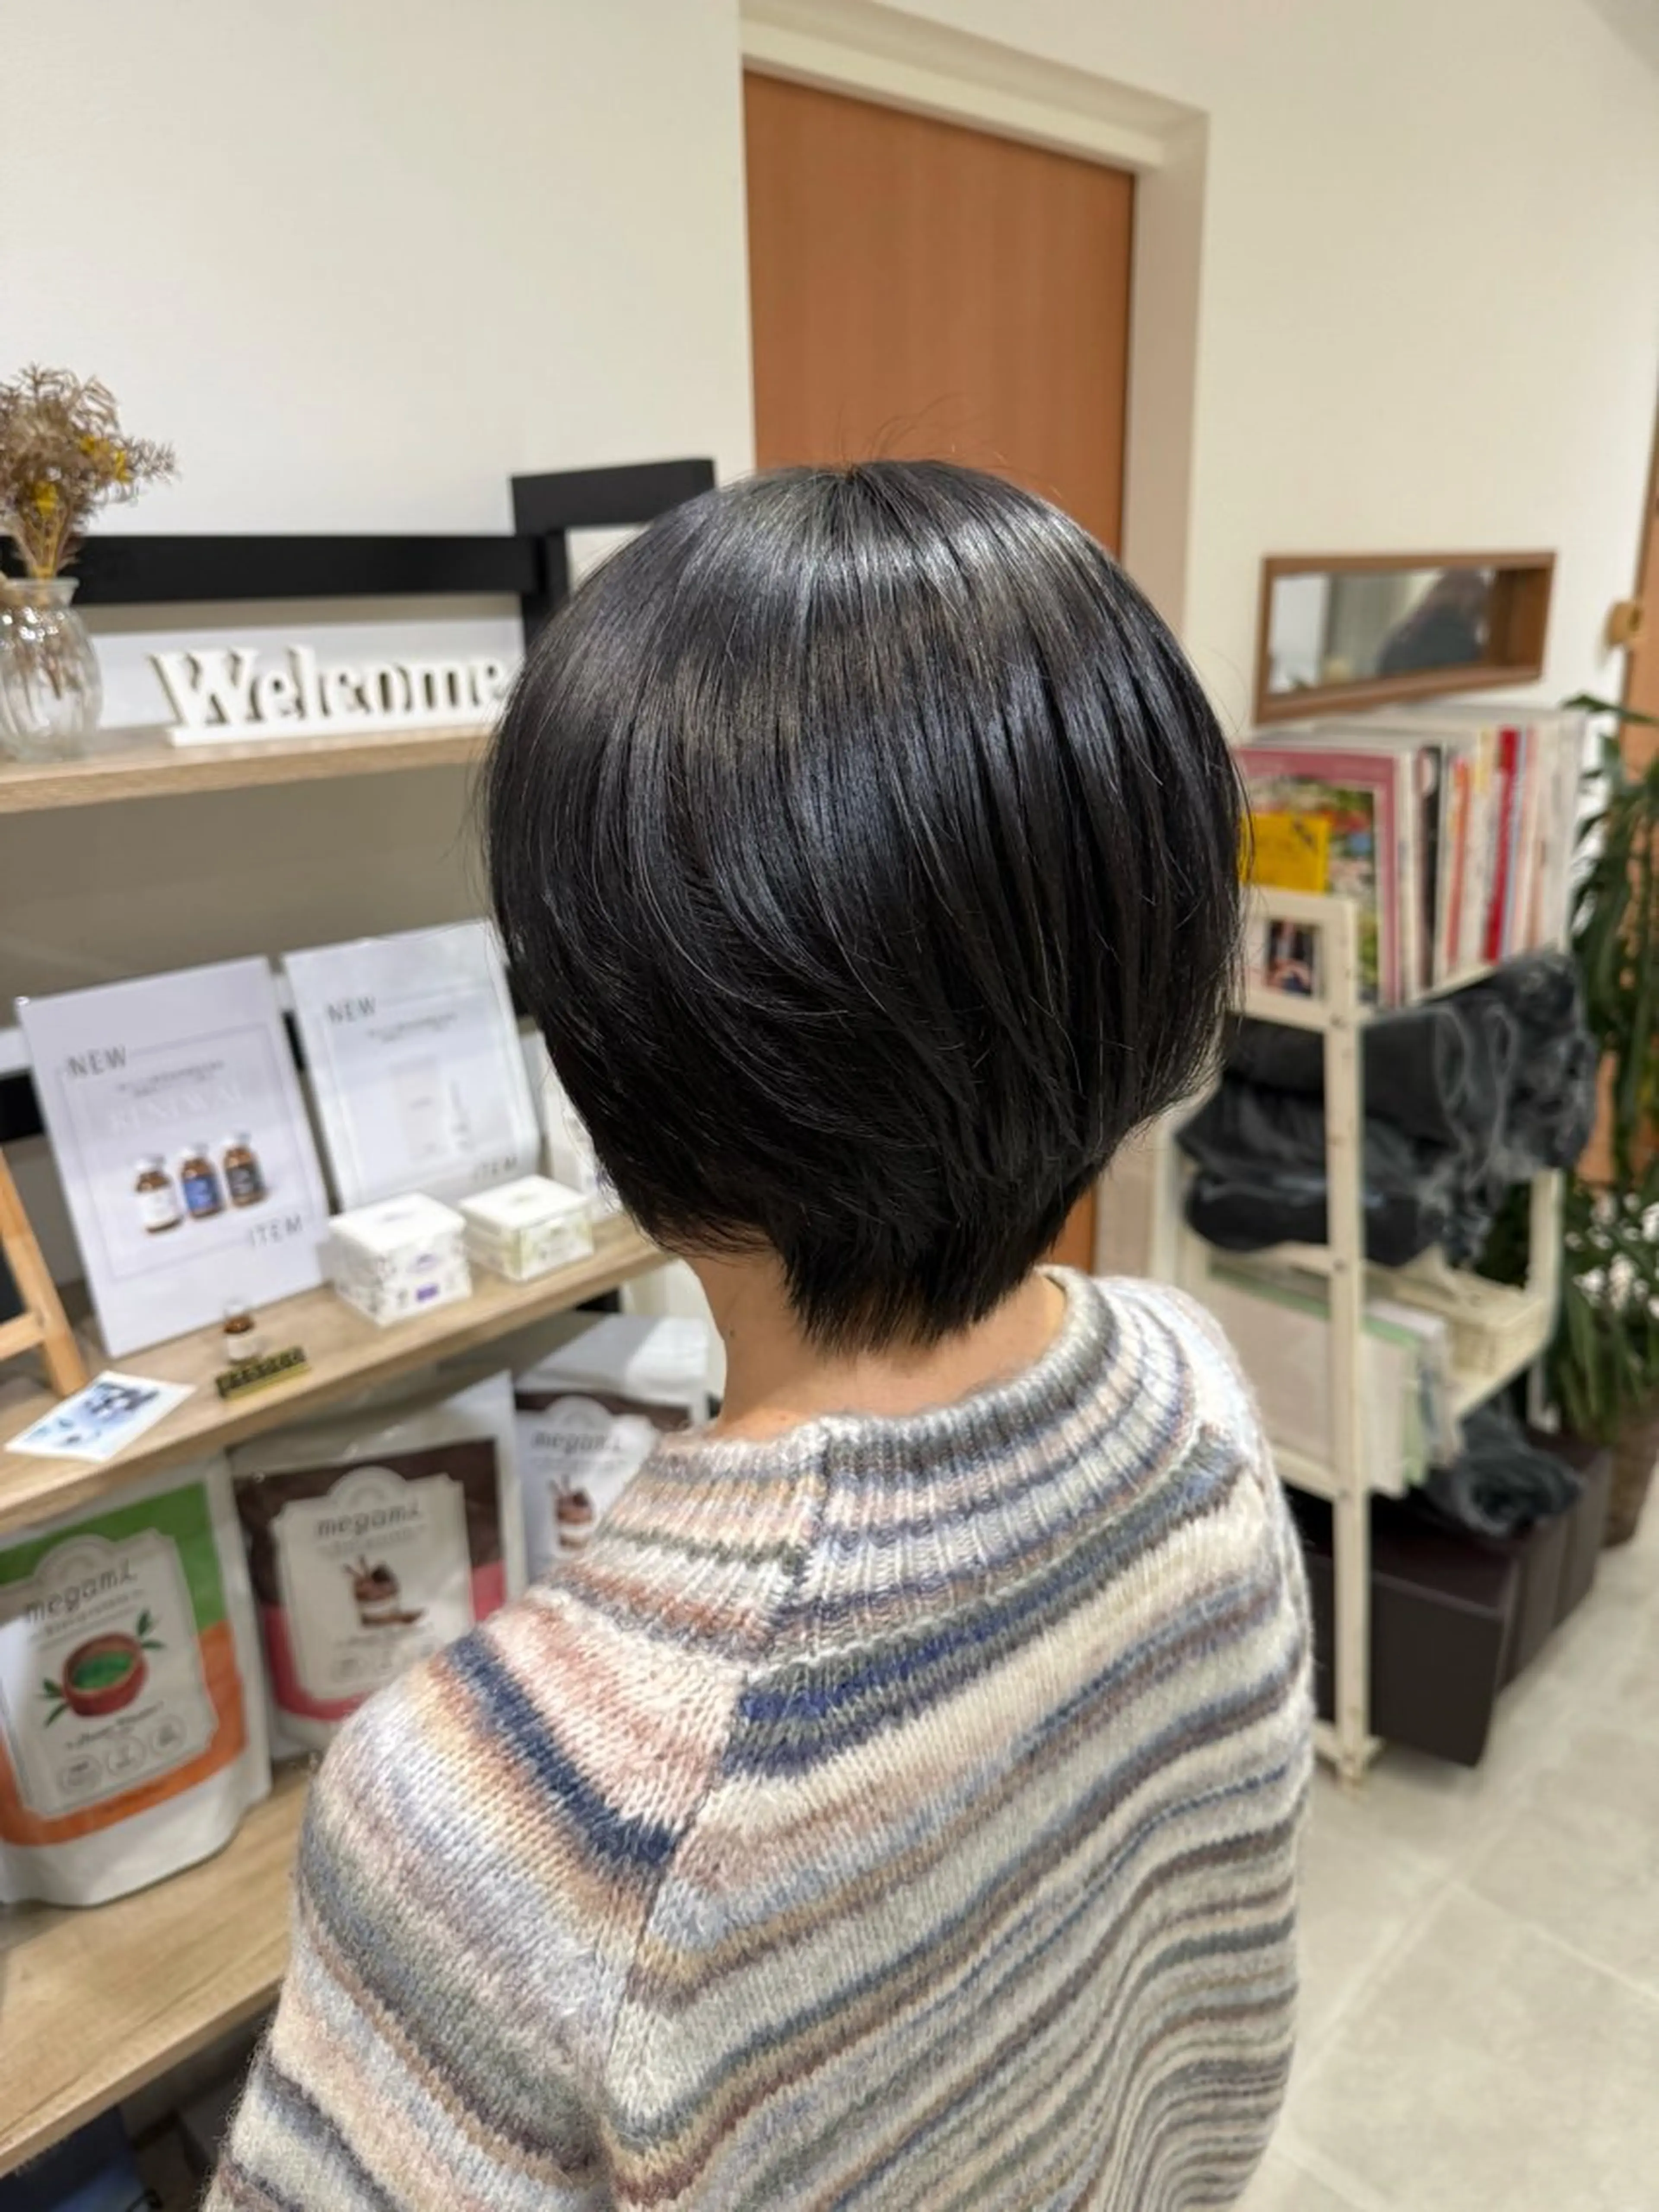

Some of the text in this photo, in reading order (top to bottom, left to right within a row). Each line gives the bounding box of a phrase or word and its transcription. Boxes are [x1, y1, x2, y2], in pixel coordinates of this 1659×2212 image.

[149, 645, 509, 727] Welcome
[327, 995, 376, 1025] NEW
[67, 1045, 126, 1077] NEW
[247, 1213, 302, 1248] ITEM
